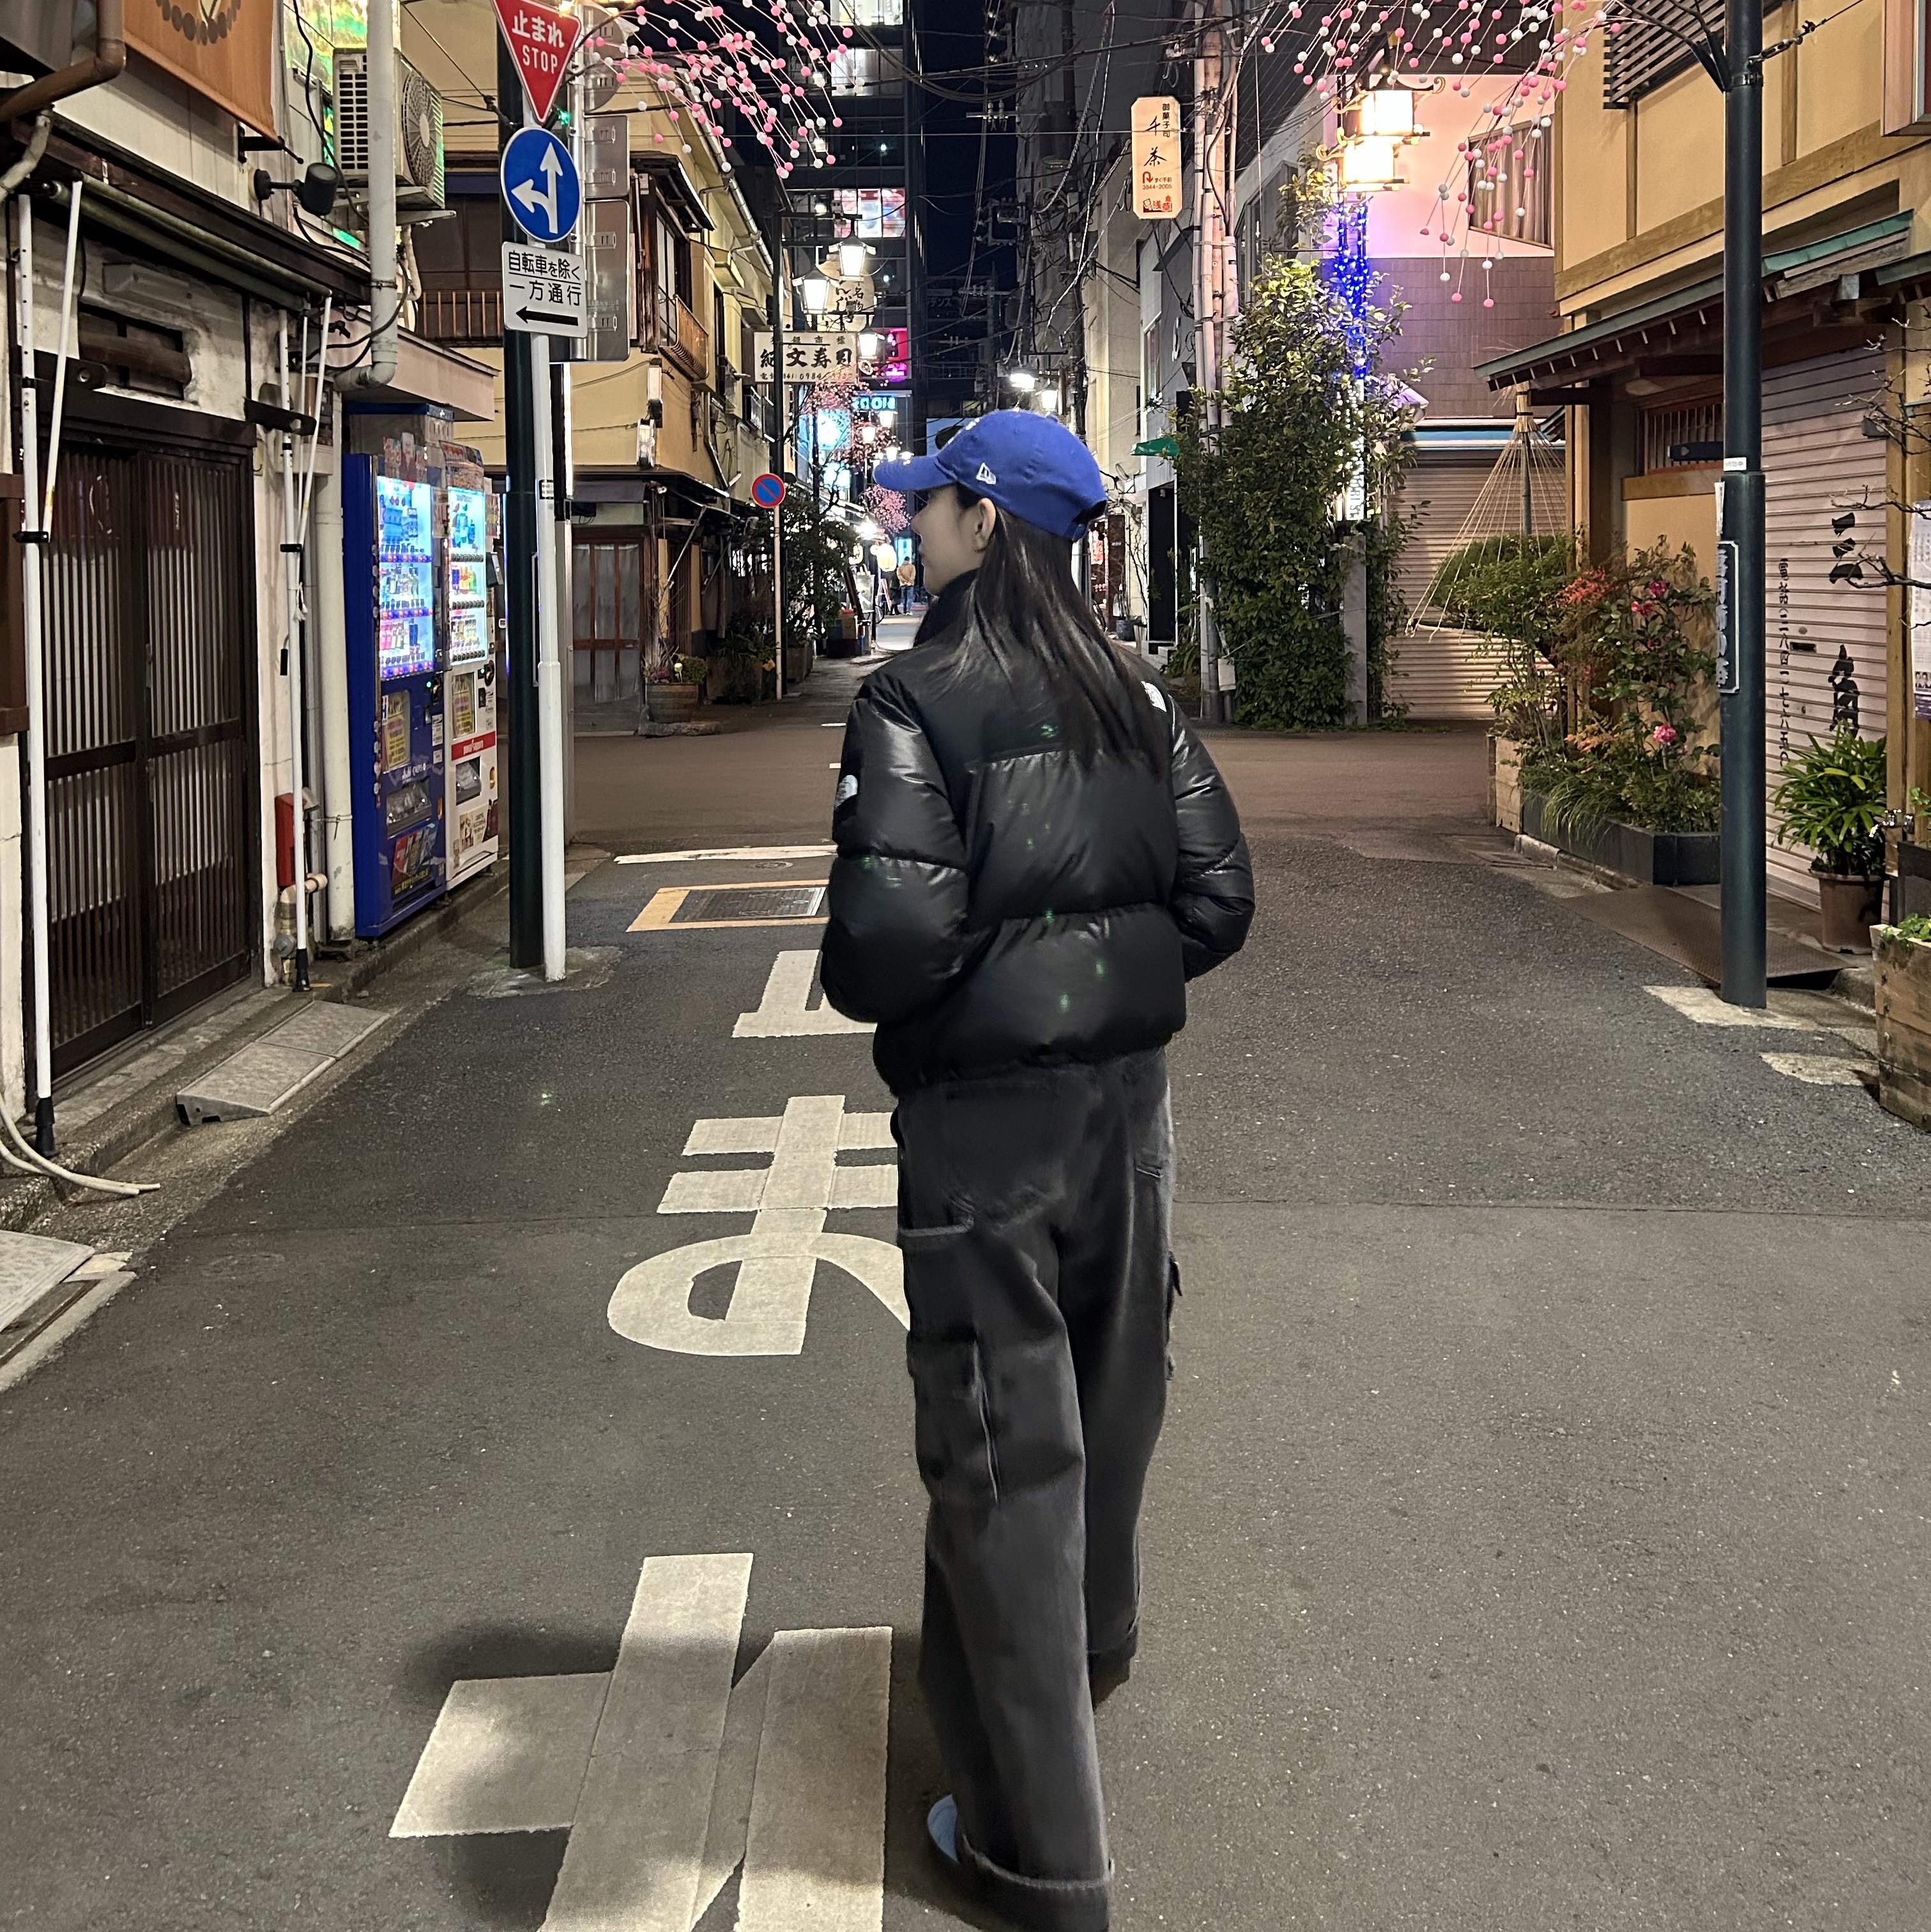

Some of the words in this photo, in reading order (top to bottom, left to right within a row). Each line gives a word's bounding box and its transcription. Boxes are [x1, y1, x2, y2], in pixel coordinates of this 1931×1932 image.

[512, 9, 565, 48] 止まれ
[522, 44, 558, 74] STOP
[1162, 103, 1170, 138] 御菓子司
[508, 249, 581, 280] 自転車を除く
[509, 279, 582, 306] 一方通行
